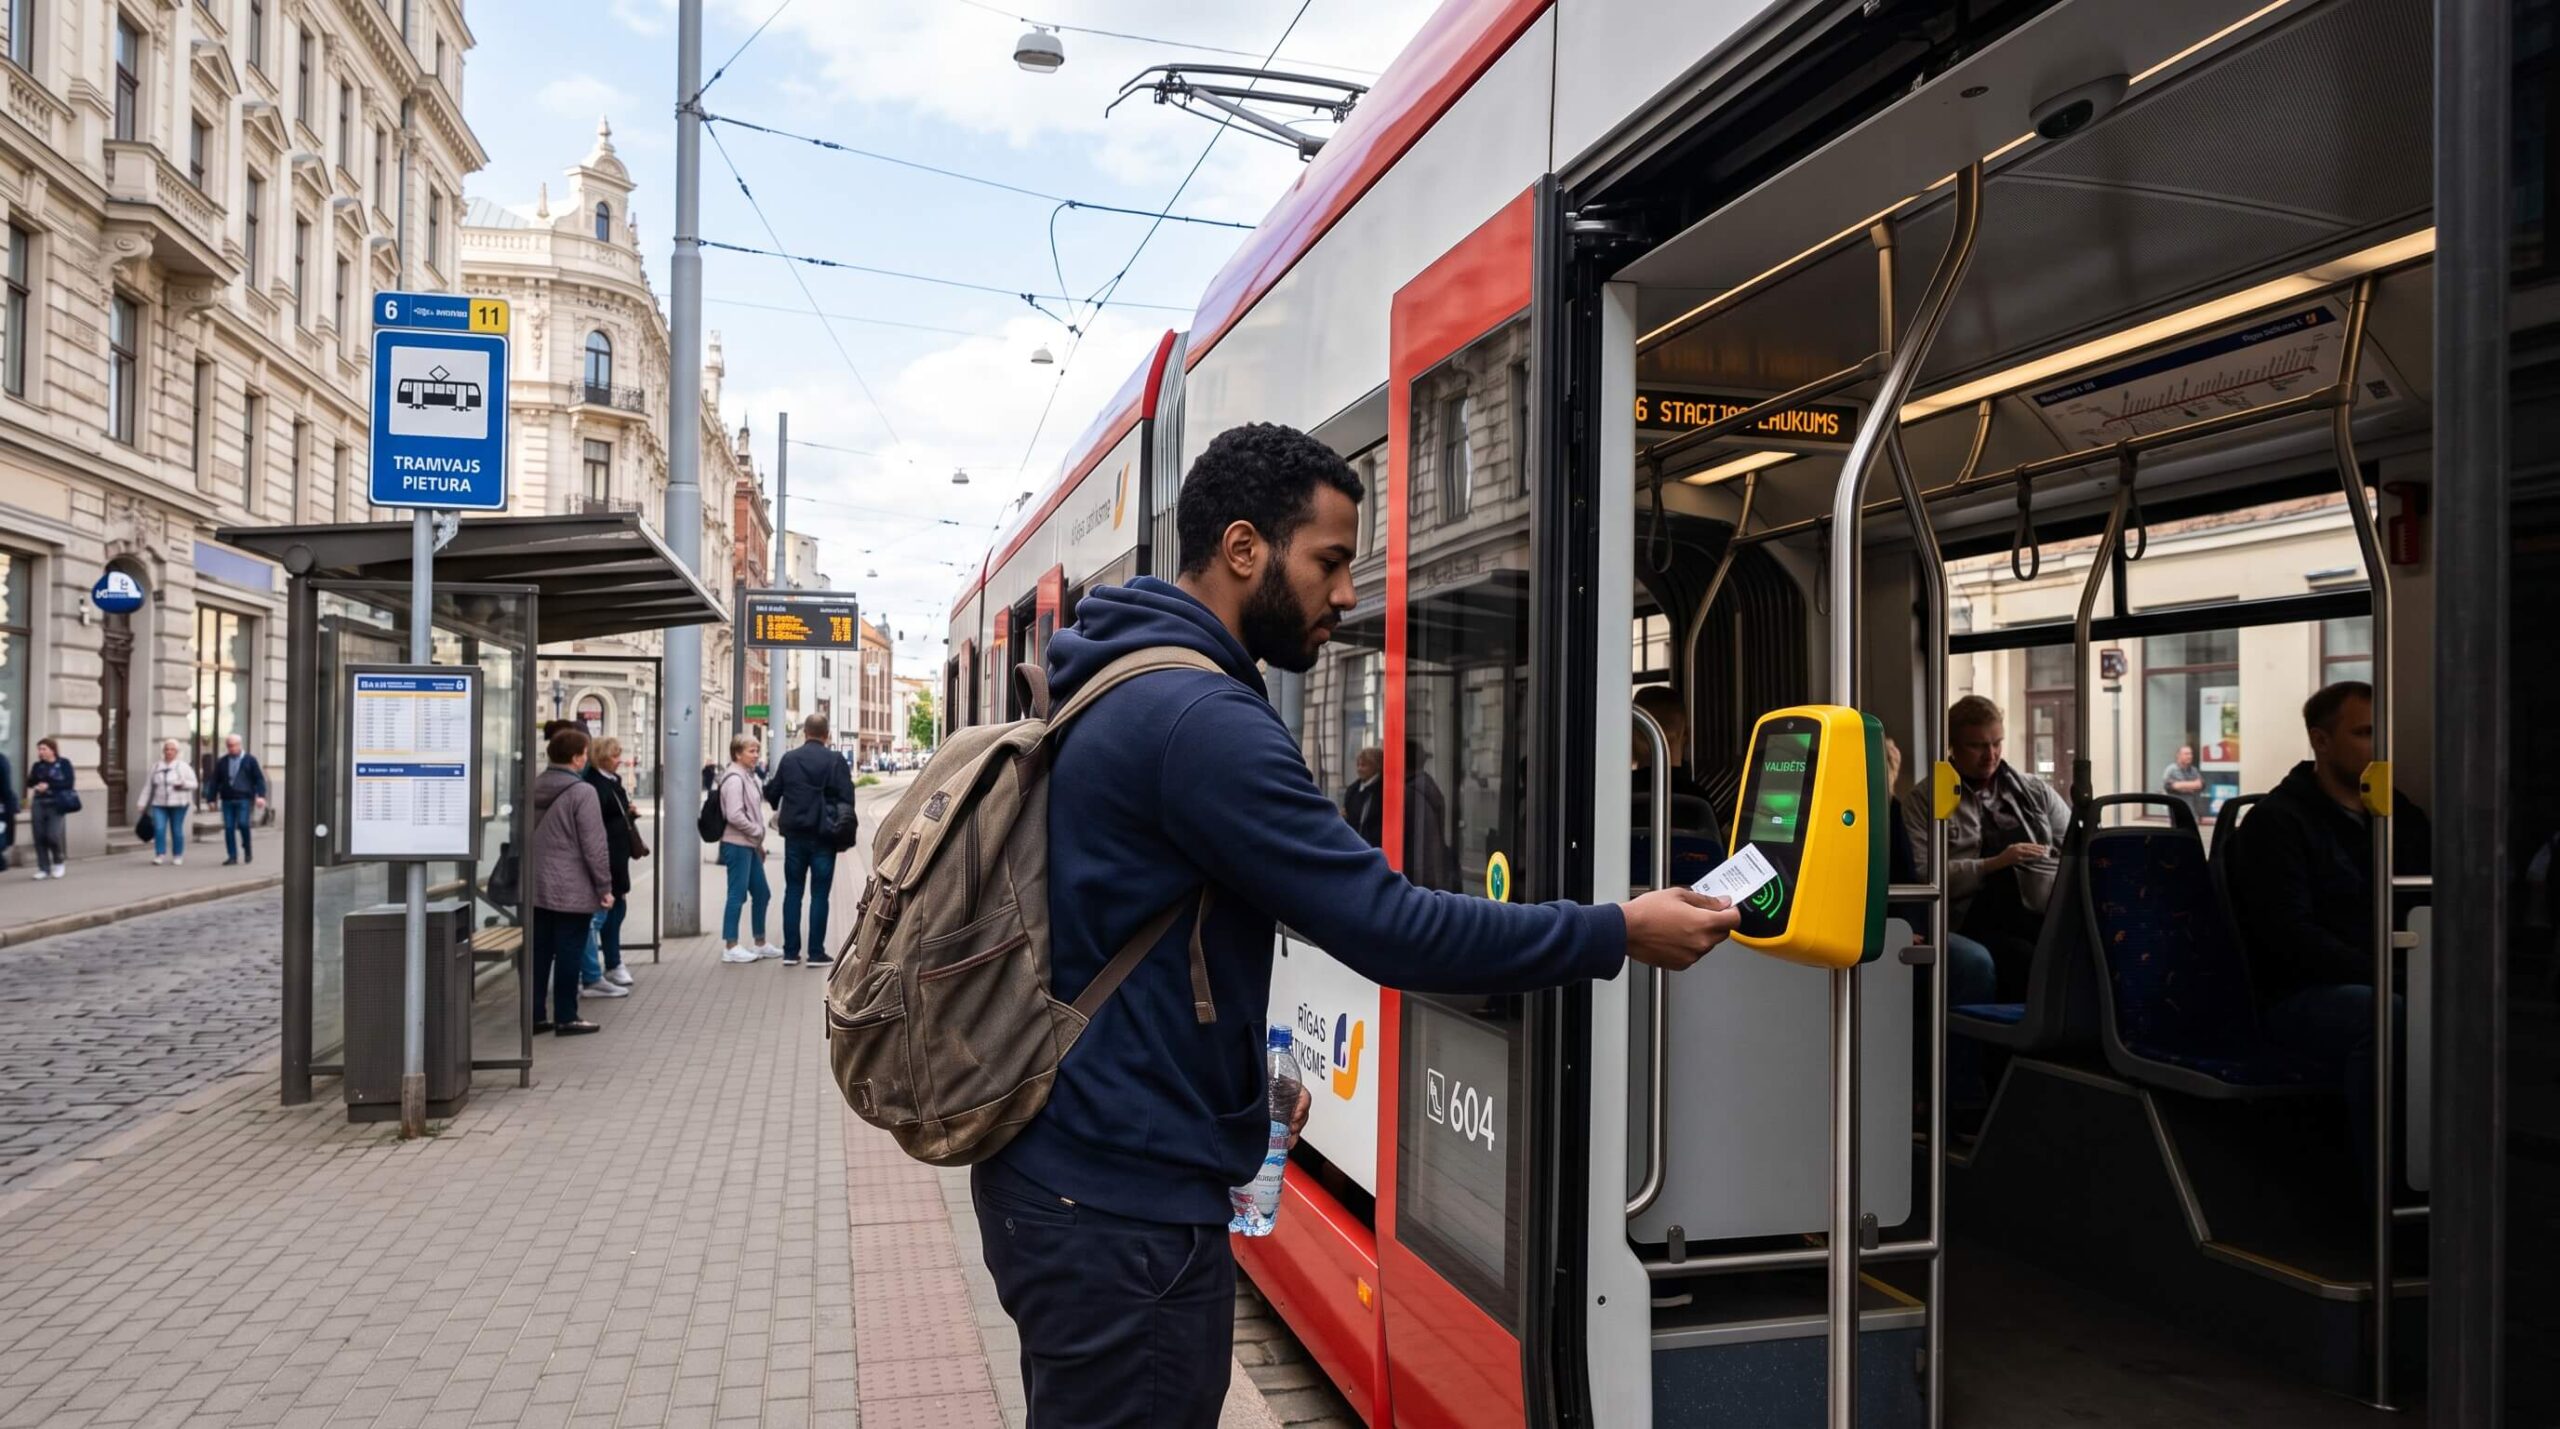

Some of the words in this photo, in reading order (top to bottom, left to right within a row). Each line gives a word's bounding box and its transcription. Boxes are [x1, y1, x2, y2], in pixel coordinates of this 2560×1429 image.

[384, 300, 398, 320] 6
[478, 306, 500, 326] 11
[1635, 396, 1648, 422] 6
[1659, 400, 1750, 425] STACIJ
[393, 455, 481, 474] TRAMVAJS
[402, 475, 472, 493] PIETURA
[1297, 1002, 1326, 1043] RĪGAS
[1293, 1037, 1326, 1081] TIKSME
[1450, 1080, 1495, 1152] 604
